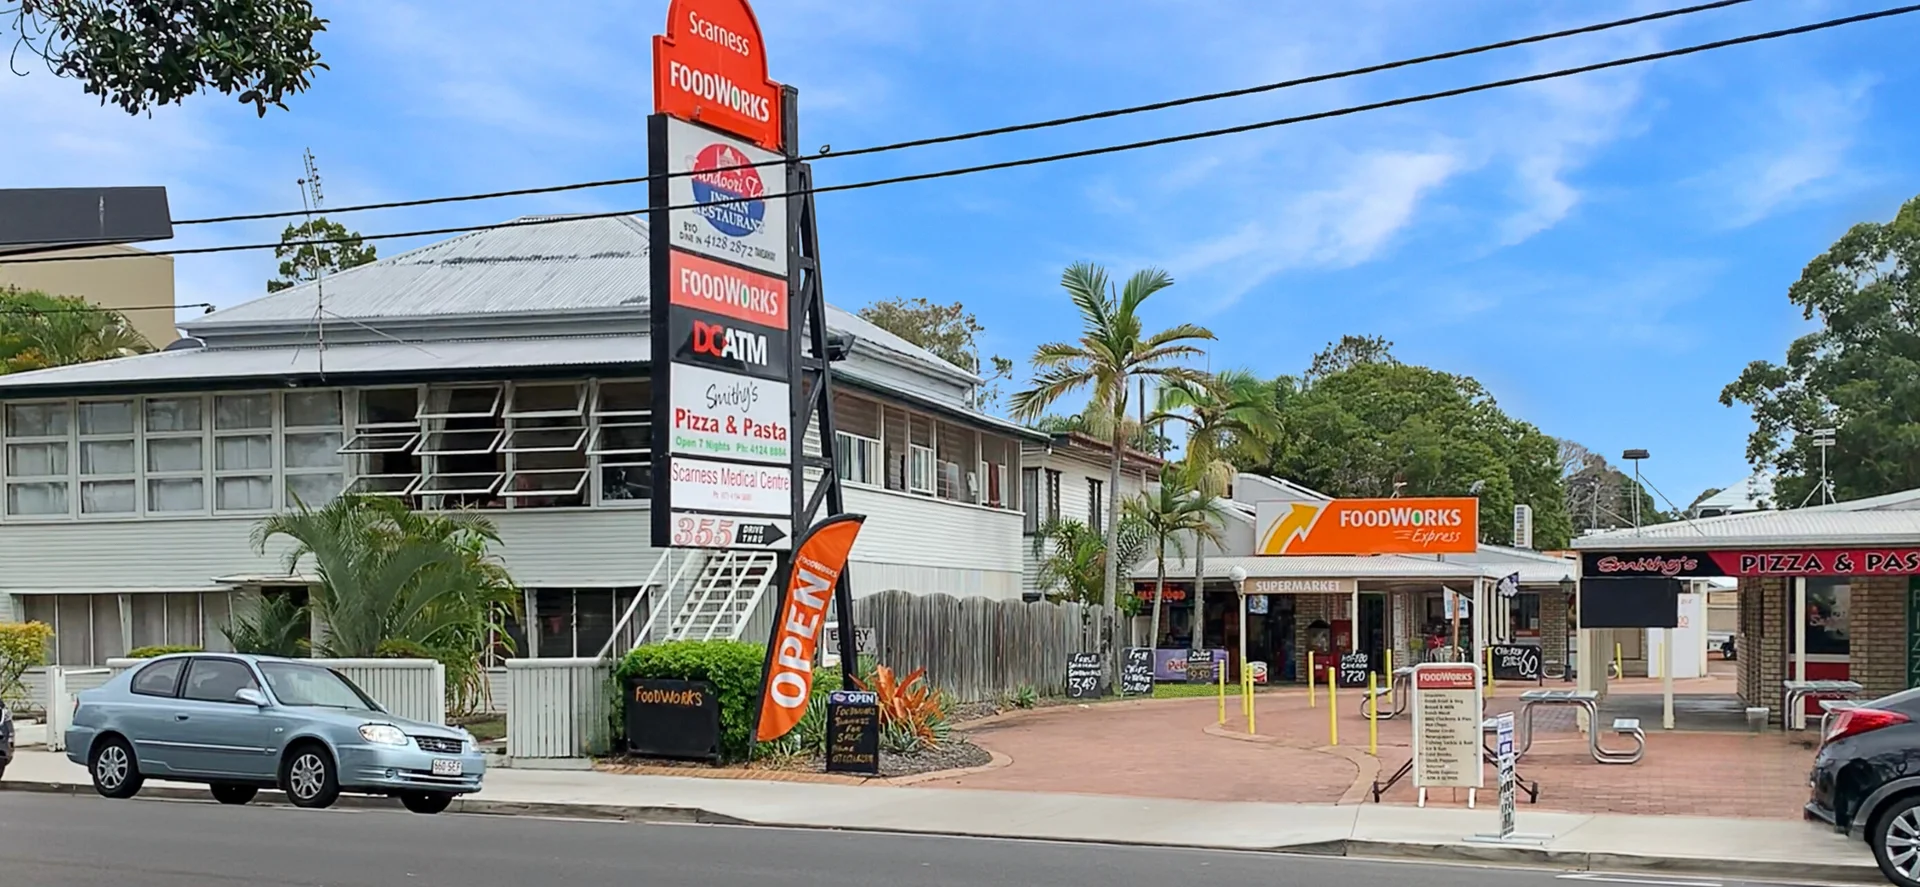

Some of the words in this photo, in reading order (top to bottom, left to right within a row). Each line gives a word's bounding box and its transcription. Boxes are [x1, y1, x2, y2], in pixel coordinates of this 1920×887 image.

[689, 11, 749, 56] Scarness
[669, 60, 770, 123] FOODWORKS
[730, 239, 754, 258] 2872
[681, 267, 779, 316] FOODWORKS
[705, 382, 758, 413] Smithy's
[675, 408, 719, 434] Pizza
[725, 415, 738, 435] &
[743, 418, 787, 441] Pasta
[706, 439, 730, 452] Nights
[672, 462, 718, 486] Scarness
[721, 467, 758, 489] Medical
[760, 471, 790, 491] Centre
[1340, 507, 1462, 528] FOODWORKS
[674, 517, 734, 546] 355
[742, 525, 765, 534] DRIVE
[742, 534, 763, 544] THRU
[1411, 528, 1462, 548] Express
[1597, 556, 1698, 576] Smithy's
[1740, 553, 1825, 573] PIZZA
[1833, 553, 1854, 572] &
[1865, 551, 1920, 572] PAS
[1255, 580, 1341, 592] SUPERMARKET
[770, 568, 832, 709] OPEN
[830, 630, 869, 641] ERY
[847, 693, 874, 704] OPEN
